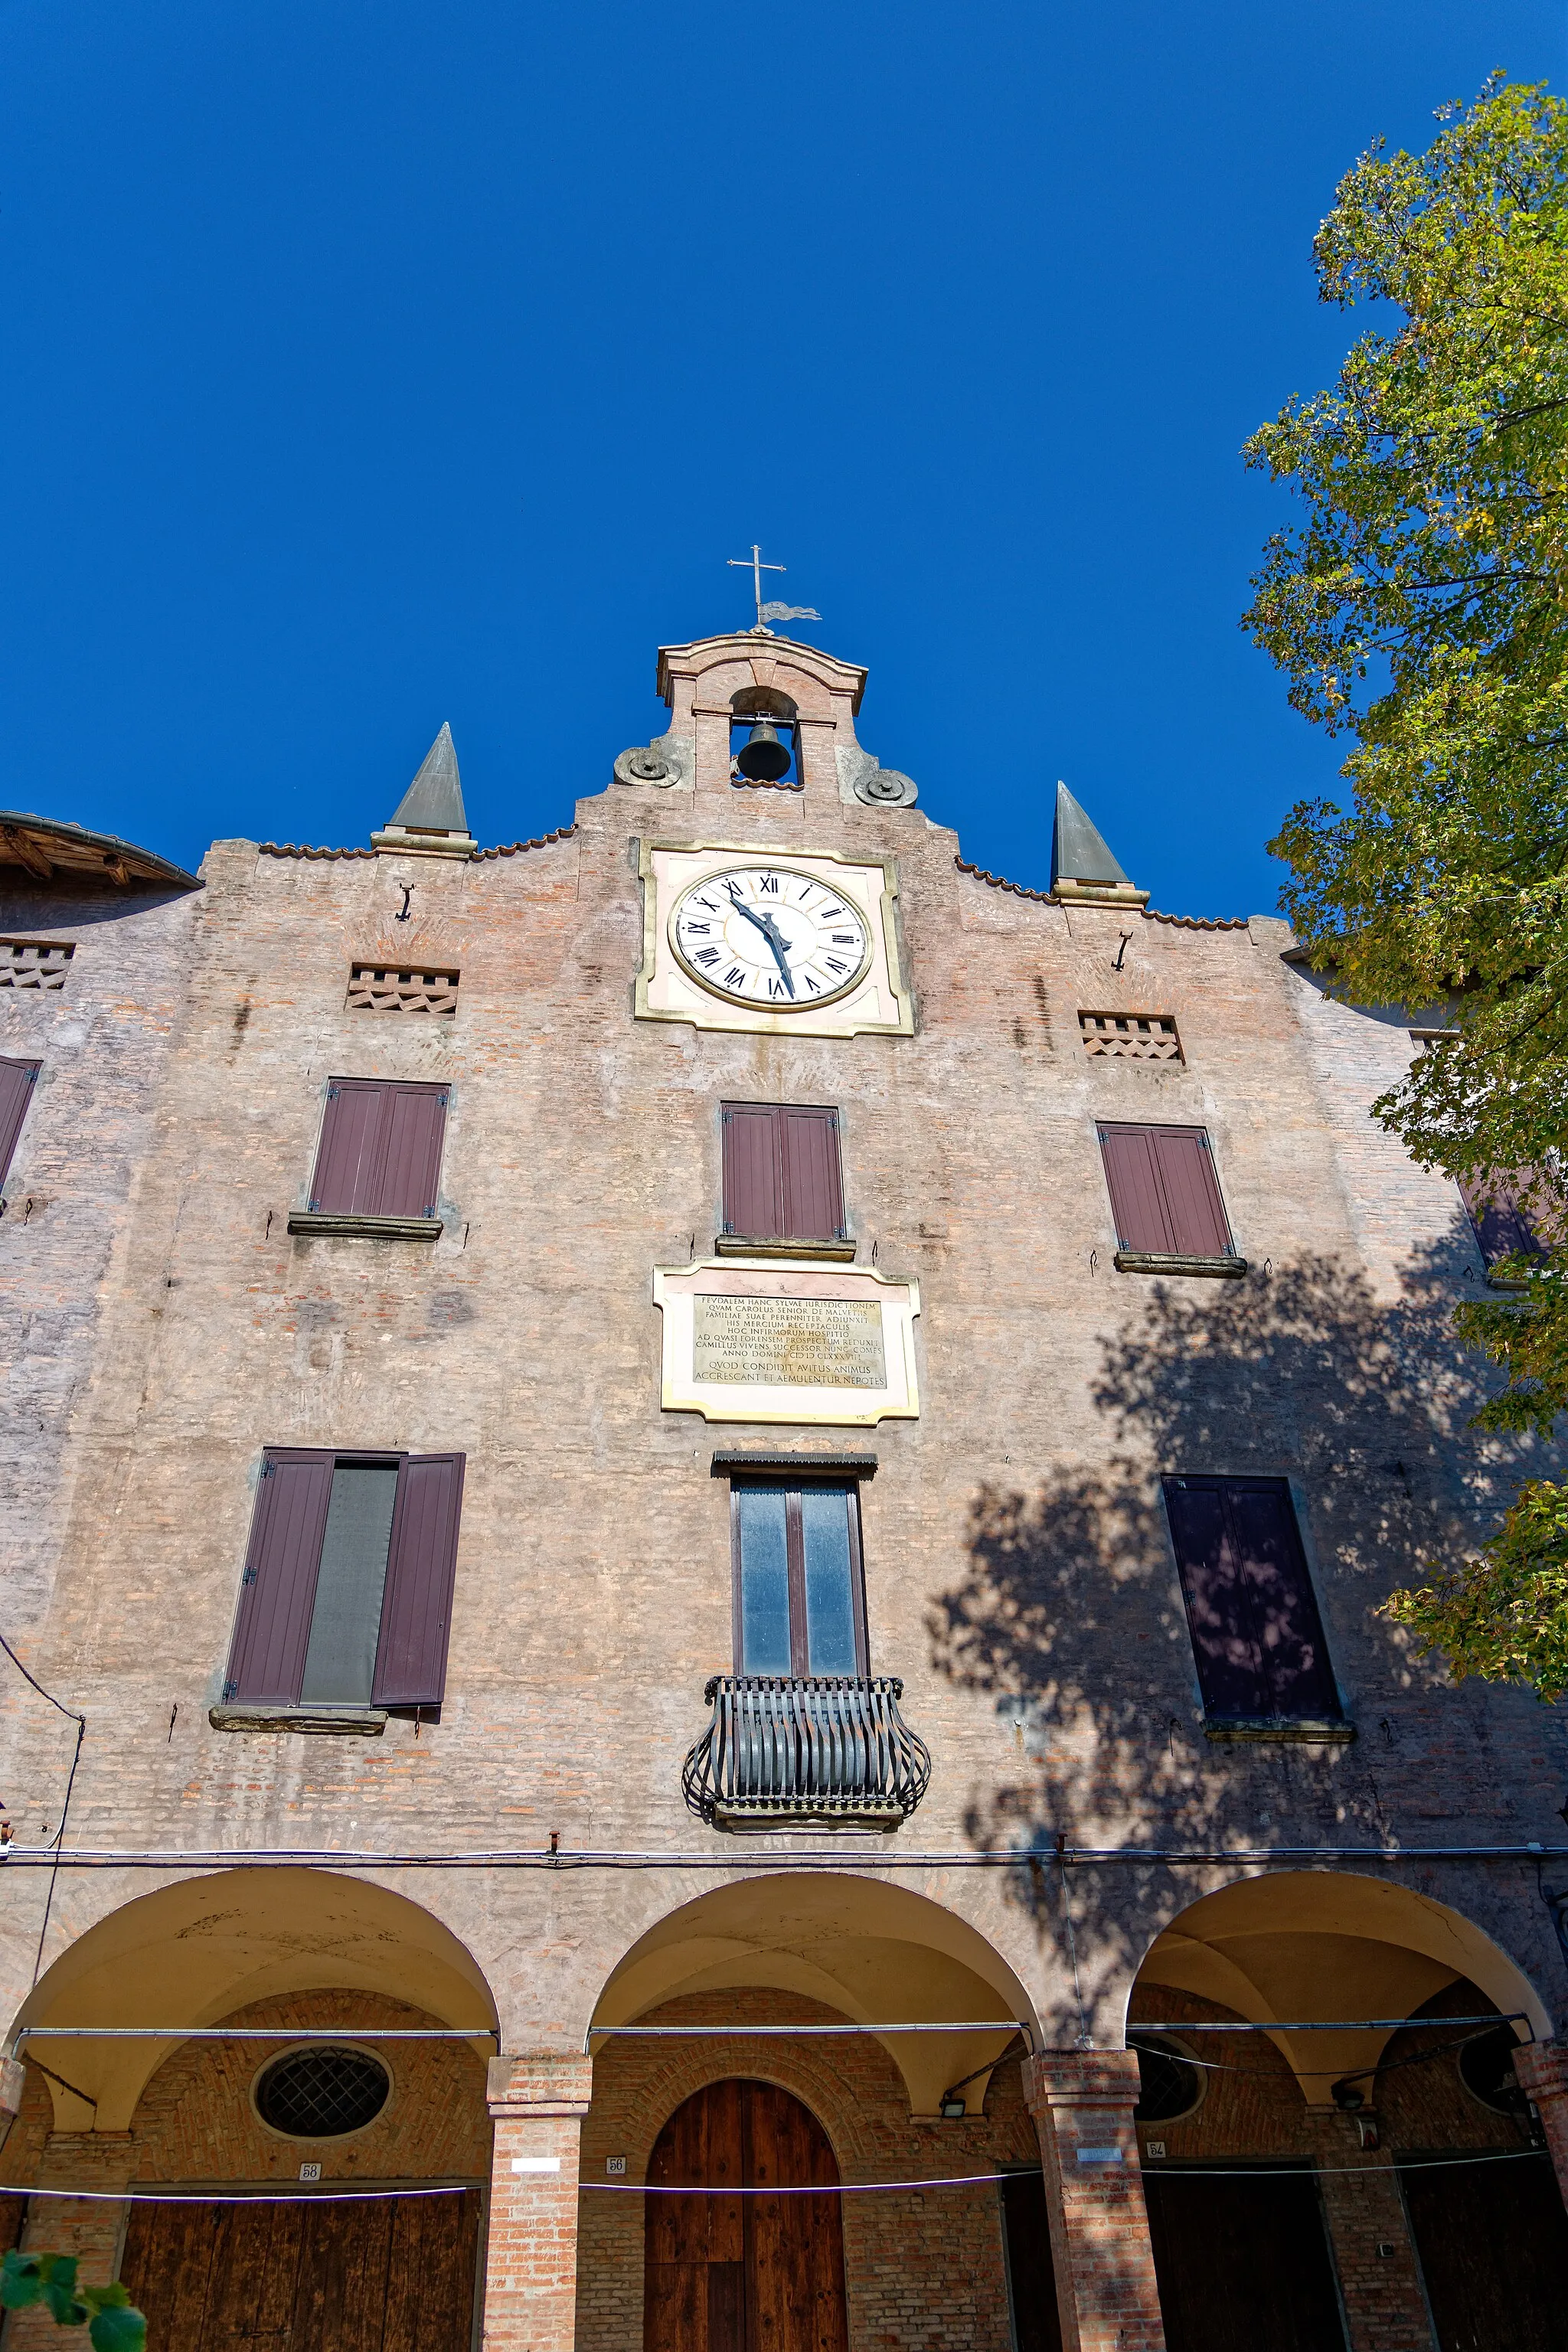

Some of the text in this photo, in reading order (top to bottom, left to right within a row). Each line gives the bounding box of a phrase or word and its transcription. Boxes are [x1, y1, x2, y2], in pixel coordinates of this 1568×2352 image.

[760, 877, 778, 893] XII
[773, 1344, 821, 1352] SUCCESSOR
[709, 1361, 738, 1372] QVOD
[743, 1362, 793, 1371] CONDIDIT
[695, 1372, 761, 1381] ACCRESCANT
[777, 1375, 841, 1383] AEMULENTUR
[844, 1377, 884, 1385] NEPOTES
[609, 2158, 622, 2171] 56
[303, 2165, 317, 2177] 58
